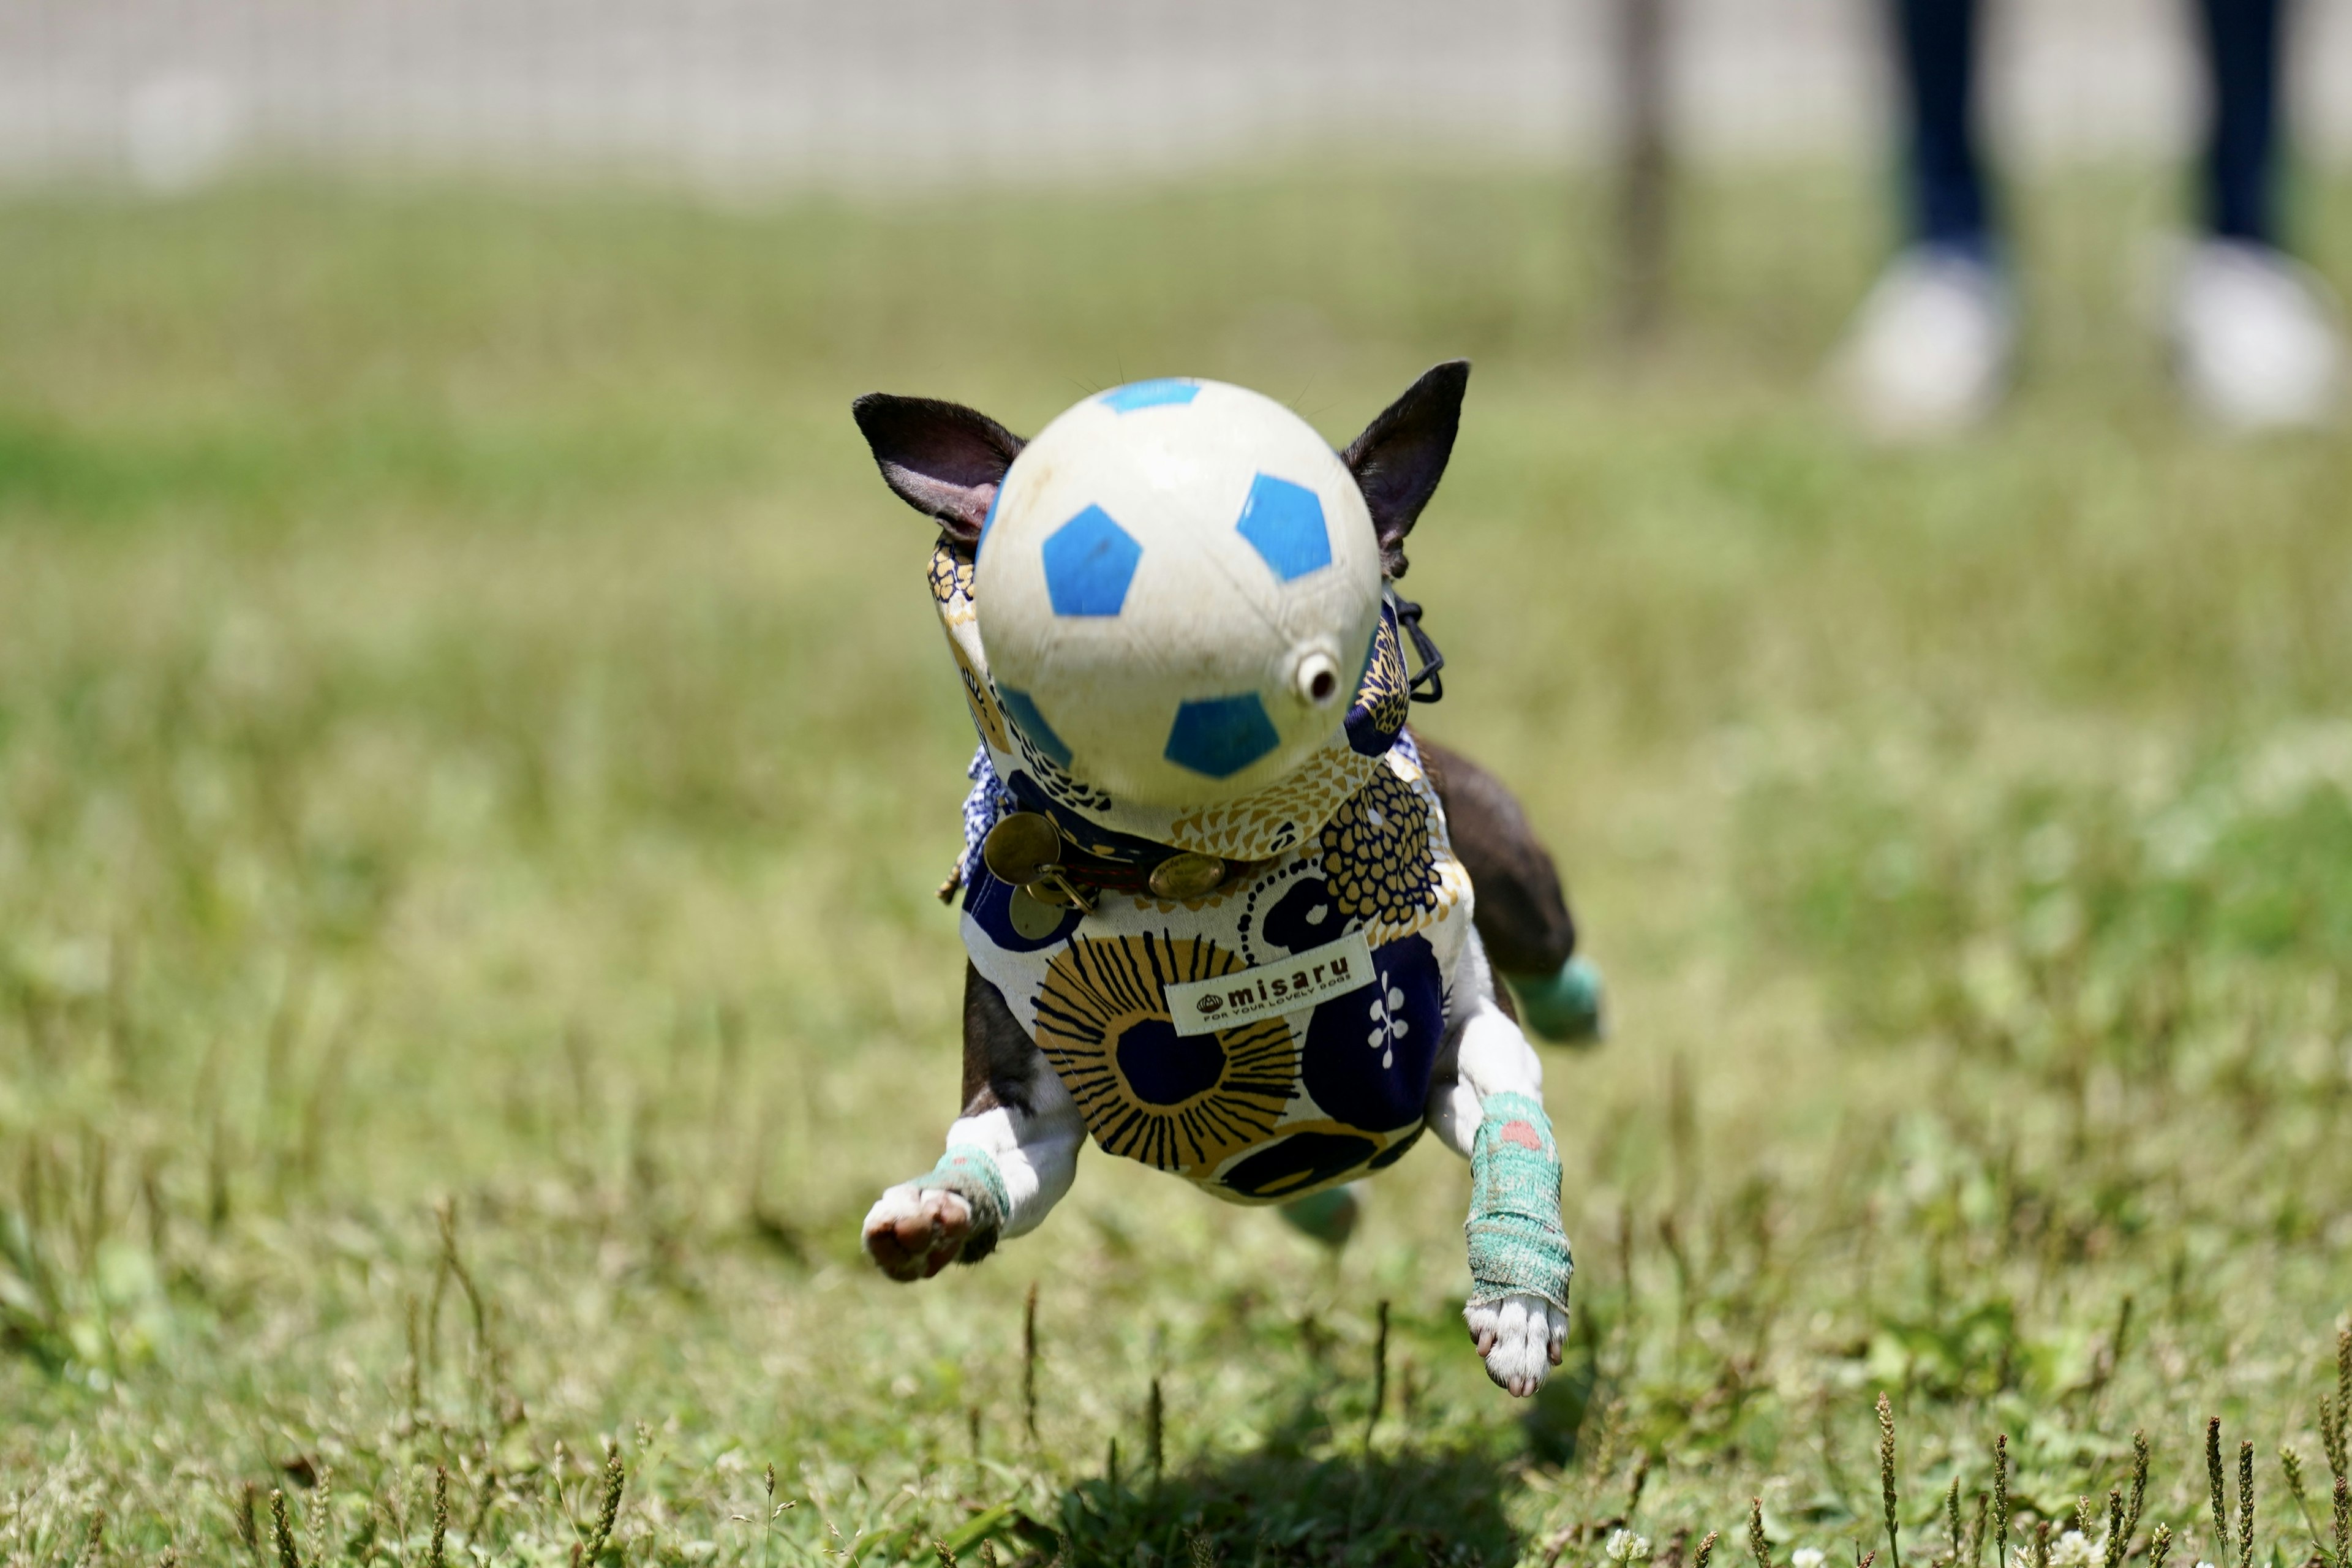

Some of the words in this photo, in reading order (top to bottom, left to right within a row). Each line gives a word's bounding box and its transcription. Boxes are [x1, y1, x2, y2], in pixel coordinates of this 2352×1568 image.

[1204, 1012, 1229, 1022] FOR
[1232, 1003, 1265, 1016] YOUR
[1268, 987, 1315, 1008] LOVELY
[1319, 973, 1351, 990] DOGS
[1227, 956, 1348, 1008] misaru
